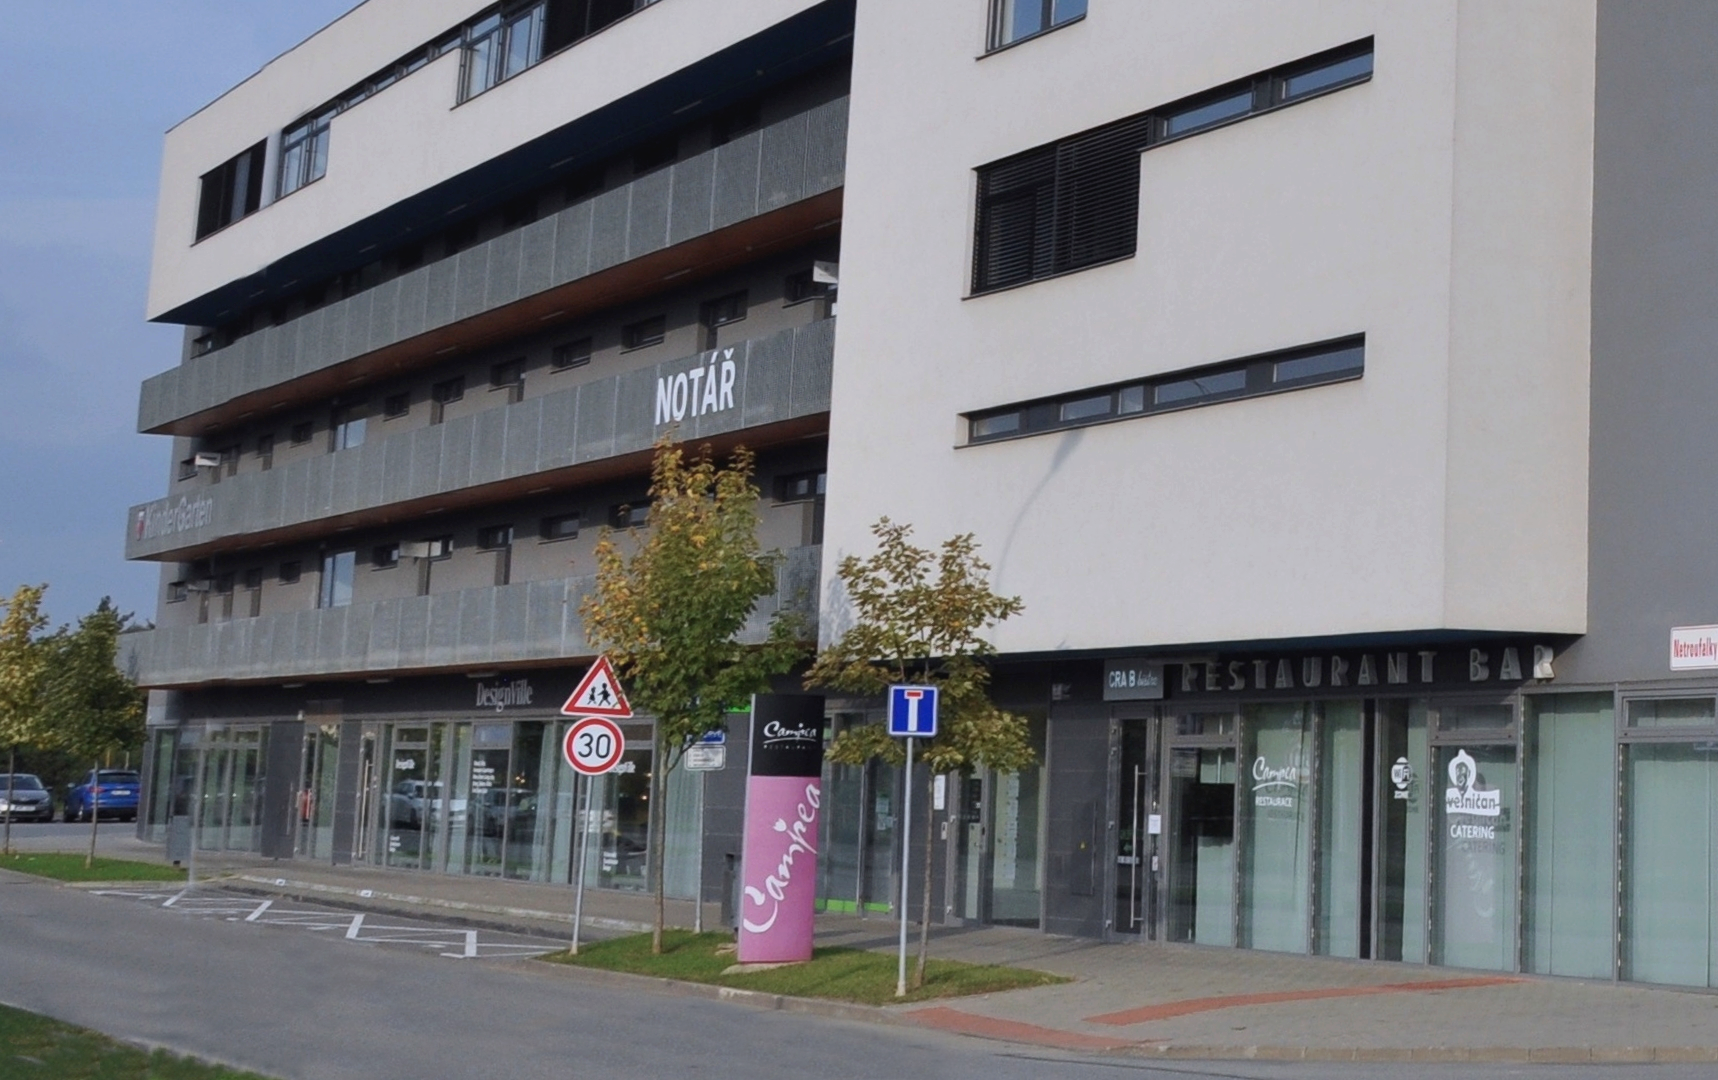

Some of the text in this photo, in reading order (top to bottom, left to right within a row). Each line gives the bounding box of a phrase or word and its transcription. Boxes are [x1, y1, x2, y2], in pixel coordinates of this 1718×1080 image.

[655, 347, 736, 426] NOTÁŘ
[1673, 636, 1718, 661] Netroufalky
[1181, 644, 1555, 693] RESTAURANT BAR
[475, 678, 534, 712] DesignVille
[577, 731, 613, 759] 30
[763, 720, 817, 743] Campea
[1252, 756, 1297, 790] Campea
[1255, 796, 1293, 808] RESTAURACE
[1450, 824, 1496, 839] CATERING
[743, 783, 821, 934] Campea
